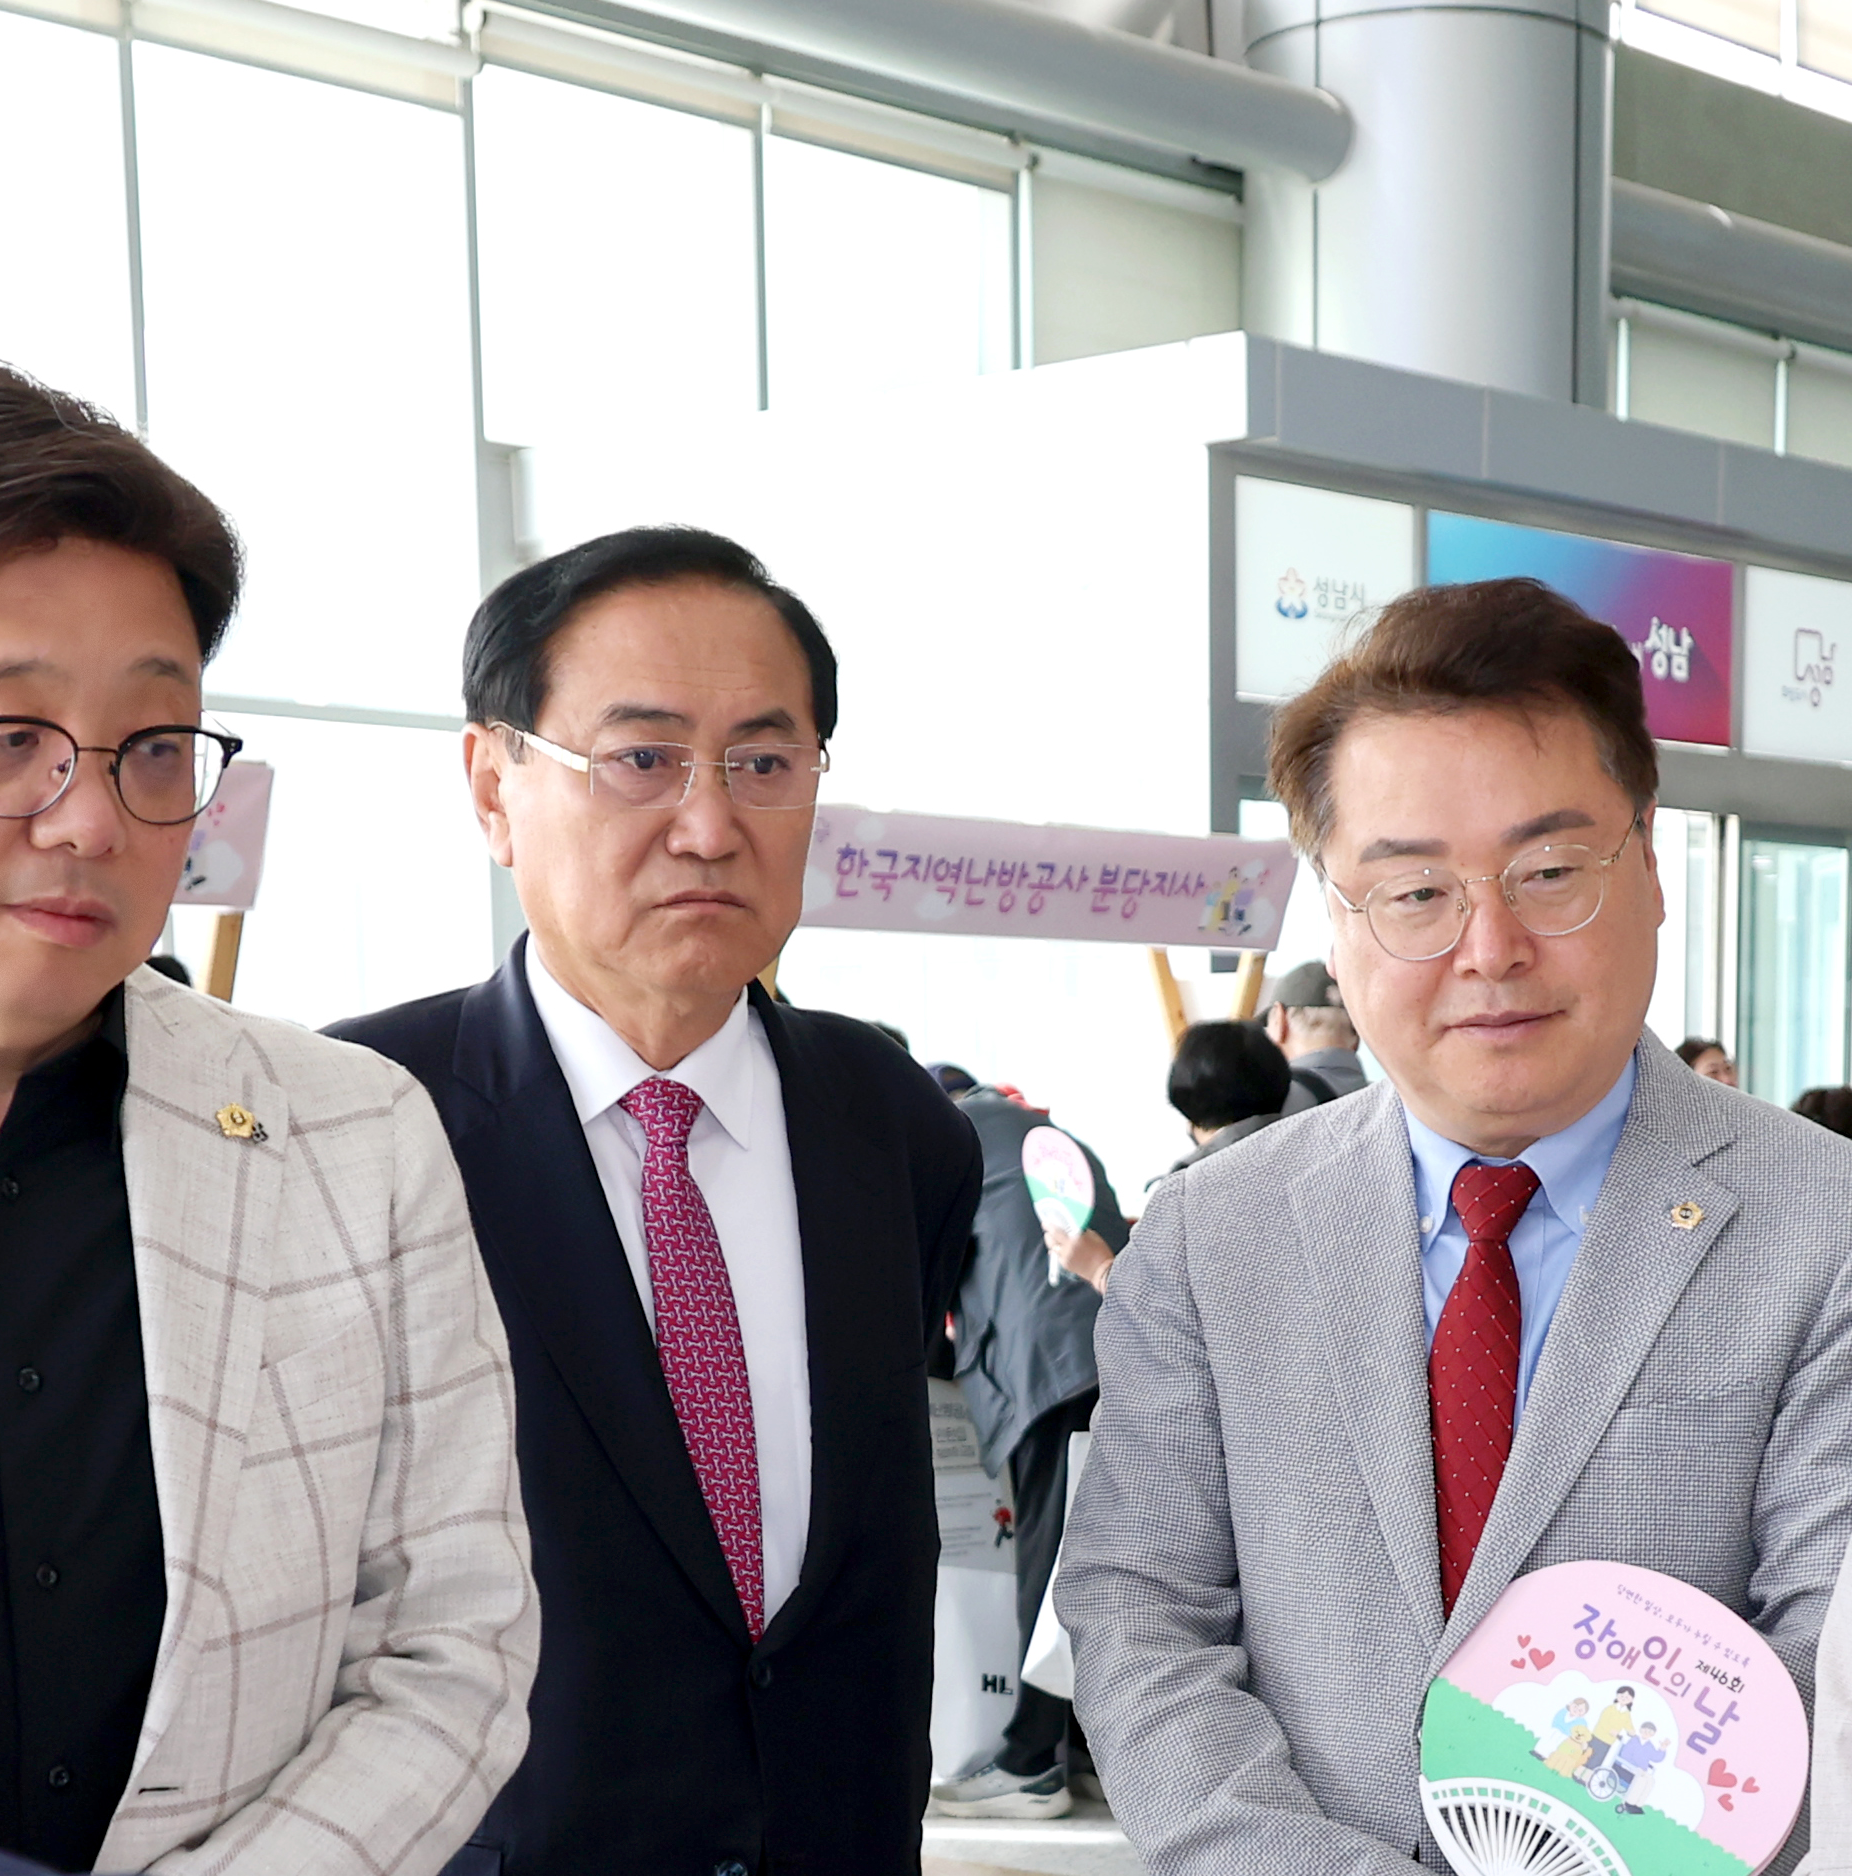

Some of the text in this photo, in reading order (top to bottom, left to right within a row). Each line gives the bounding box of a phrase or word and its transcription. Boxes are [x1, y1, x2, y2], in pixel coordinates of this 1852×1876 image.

[836, 842, 1207, 920] 한국지역난방공사 분당지사
[981, 1673, 1014, 1696] HL
[1572, 1603, 1740, 1755] 장애인의 날
[1694, 1659, 1746, 1694] 제46회
